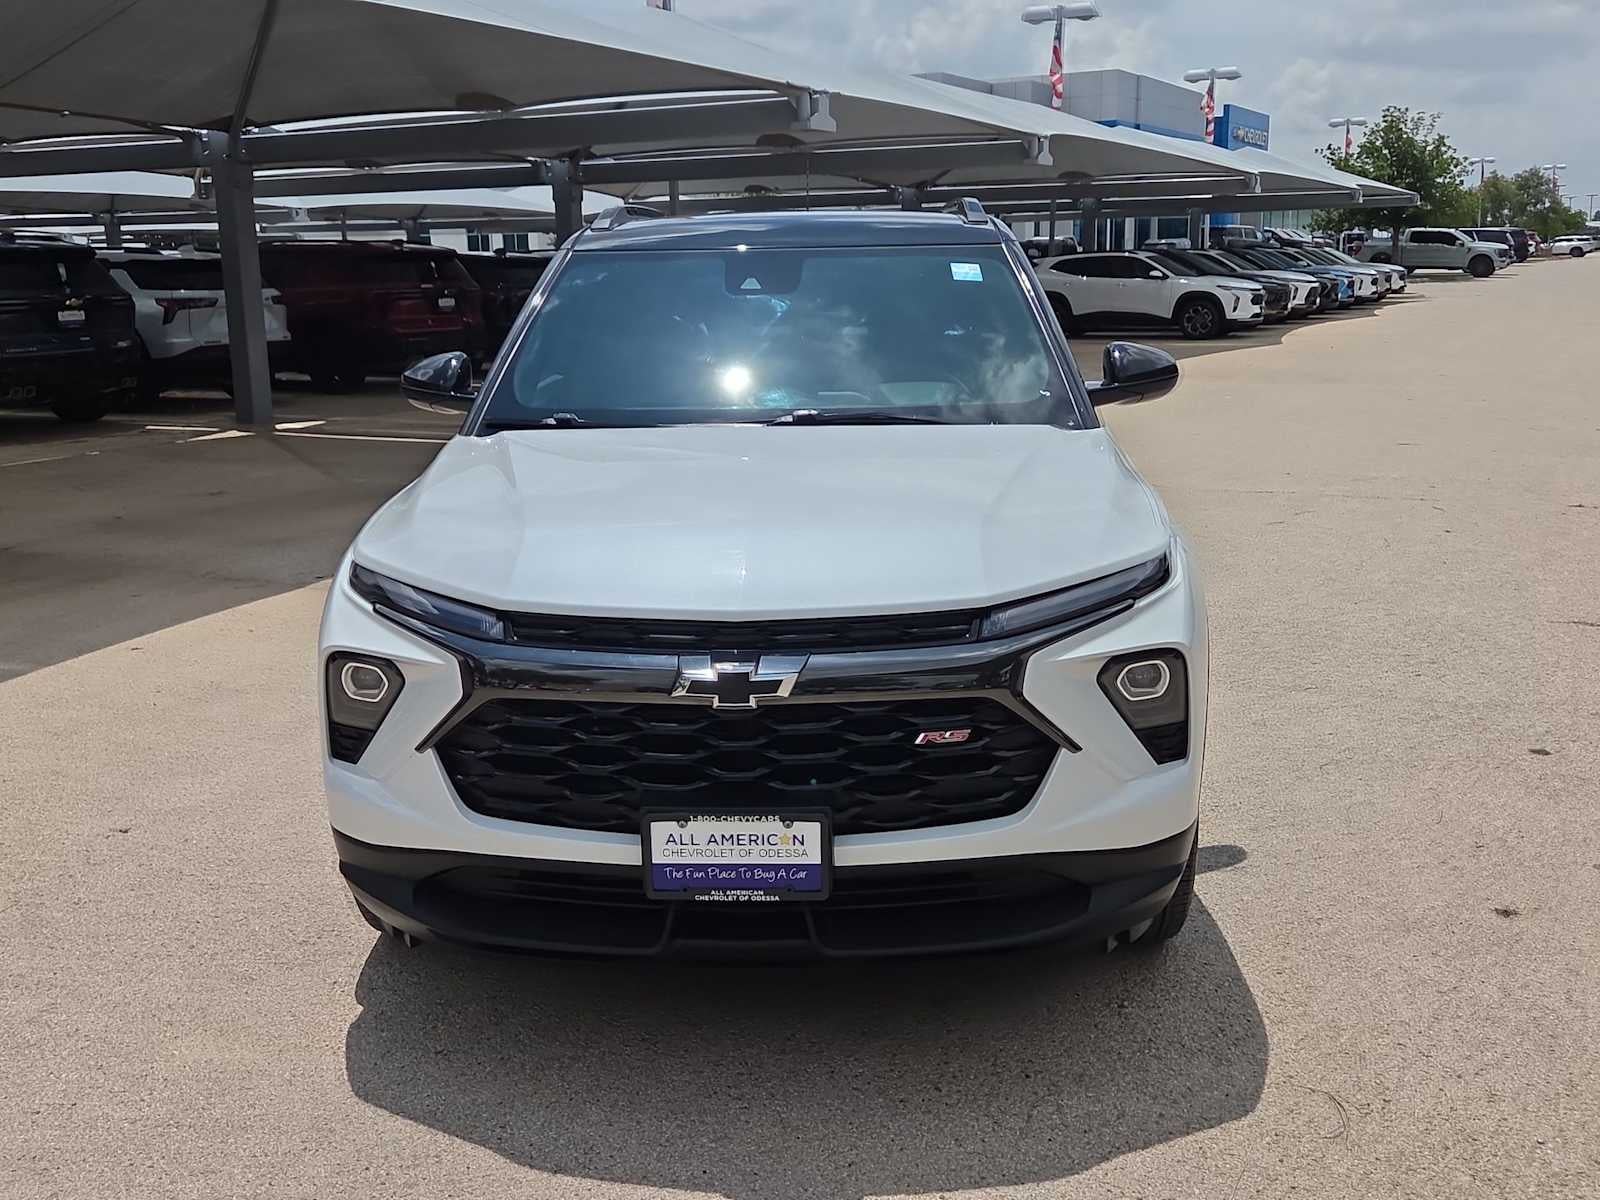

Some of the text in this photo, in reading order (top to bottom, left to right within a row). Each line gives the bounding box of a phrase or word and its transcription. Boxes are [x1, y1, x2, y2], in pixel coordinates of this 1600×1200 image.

[914, 729, 971, 744] RS
[665, 833, 701, 846] ALL
[662, 848, 809, 858] CHEVROLET OF ODESSA
[664, 866, 808, 882] The Fun Place To Buy A Car
